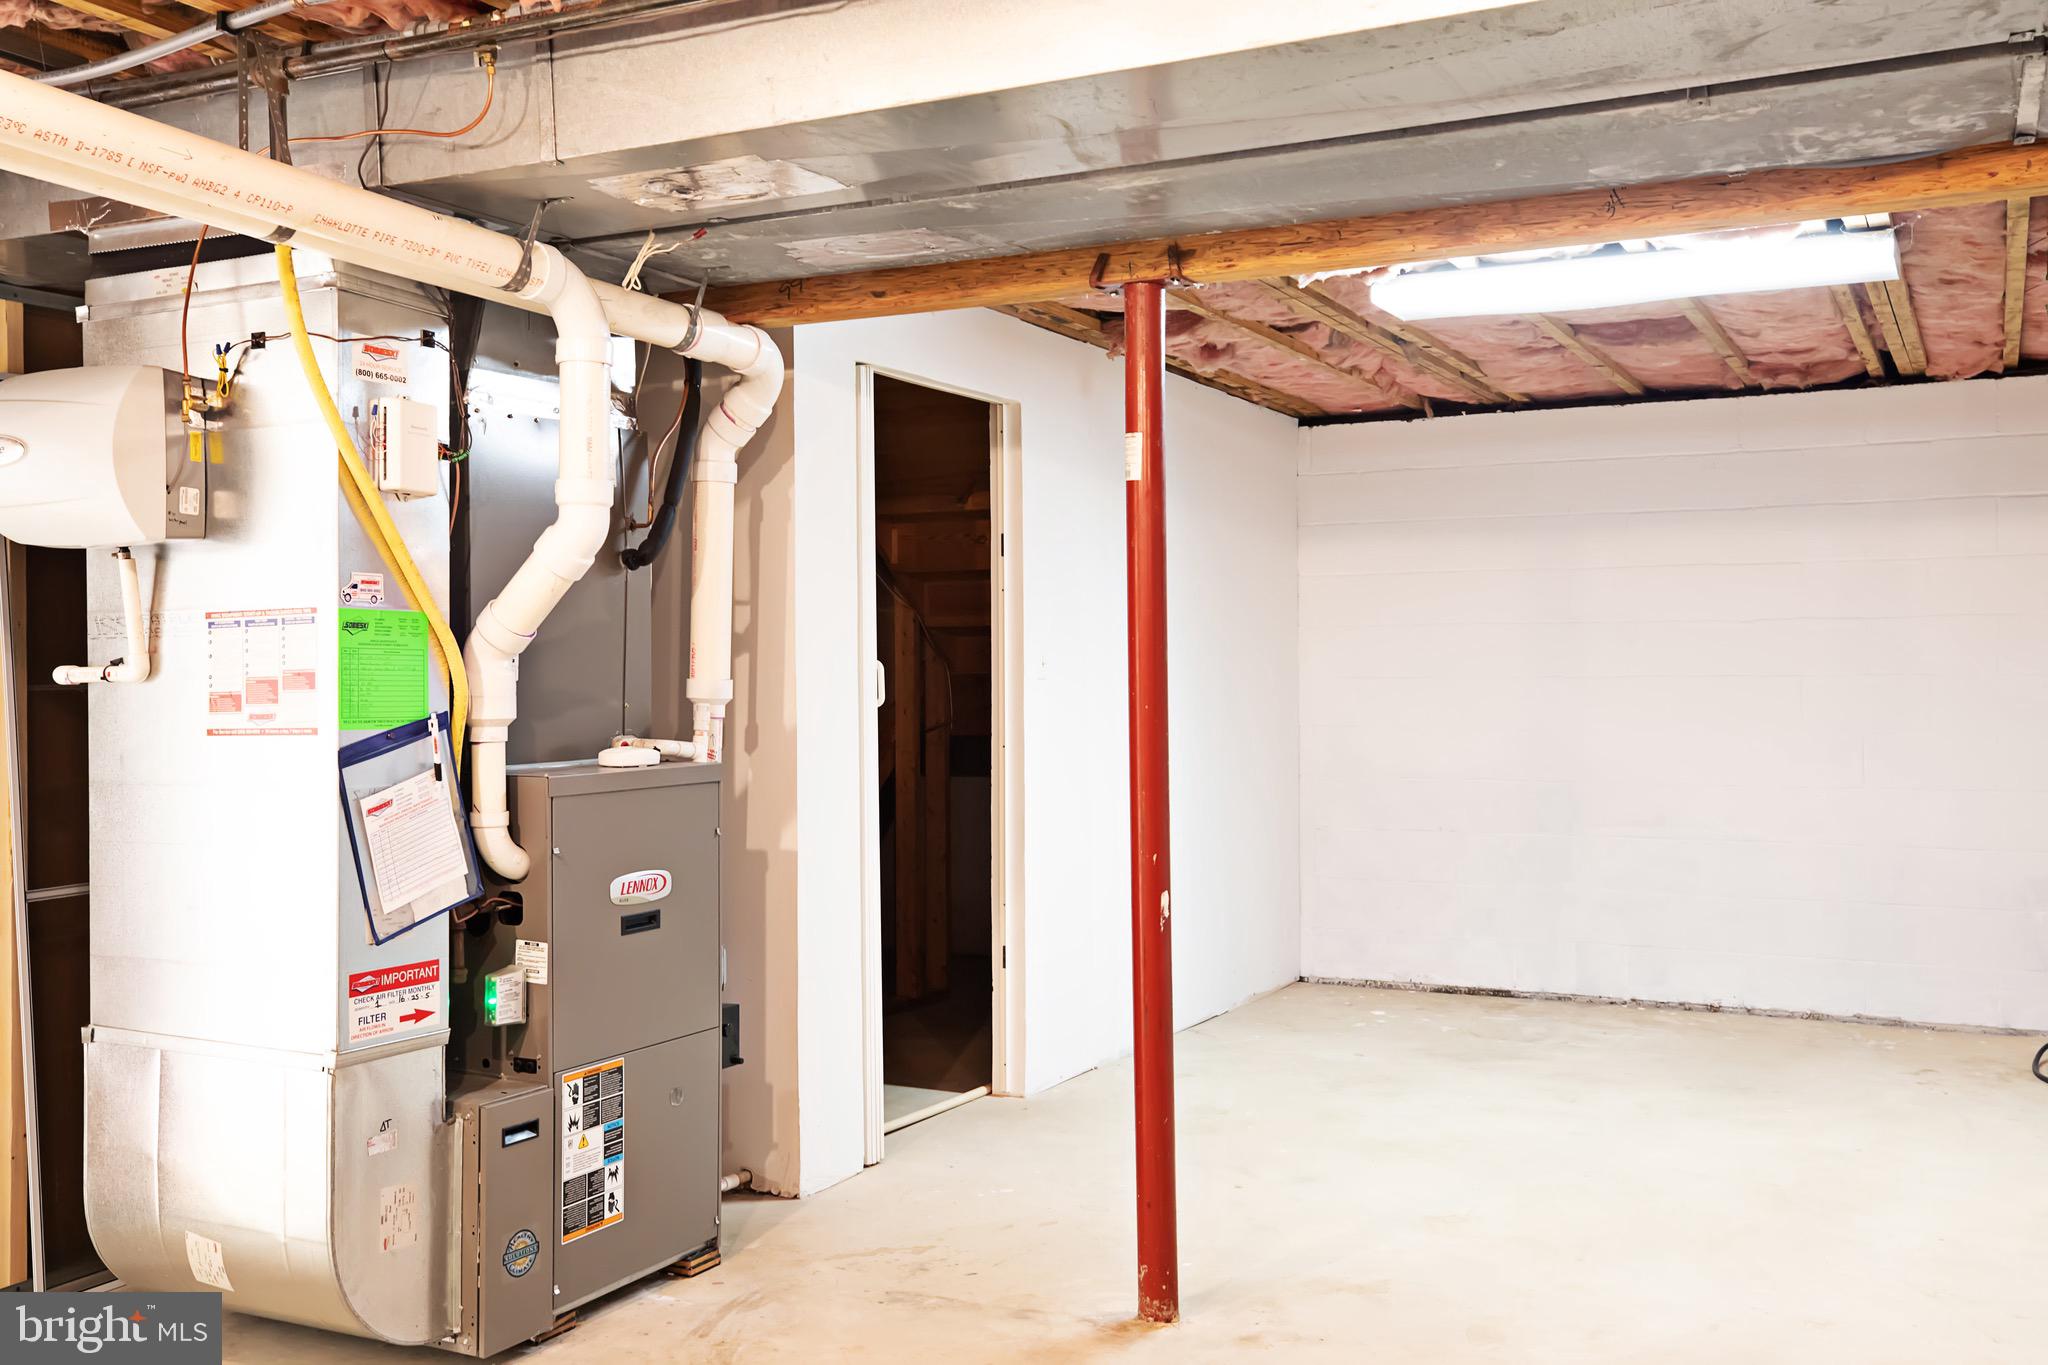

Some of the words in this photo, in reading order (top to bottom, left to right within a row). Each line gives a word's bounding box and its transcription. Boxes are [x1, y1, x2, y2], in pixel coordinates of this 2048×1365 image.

[33, 129, 68, 147] ASTM
[74, 141, 123, 163] D-1785
[313, 213, 369, 238] CHARLOTTE
[372, 231, 398, 246] PIPE
[444, 251, 463, 265] PVC
[355, 368, 374, 379] (800)
[620, 877, 659, 896] LENNOX
[381, 965, 439, 985] IMPORTANT
[353, 996, 375, 1005] CHECK
[387, 989, 407, 998] FILTER
[408, 985, 435, 994] MONTHLY
[358, 1012, 387, 1026] FILTER
[351, 1031, 372, 1040] DIRECTION
